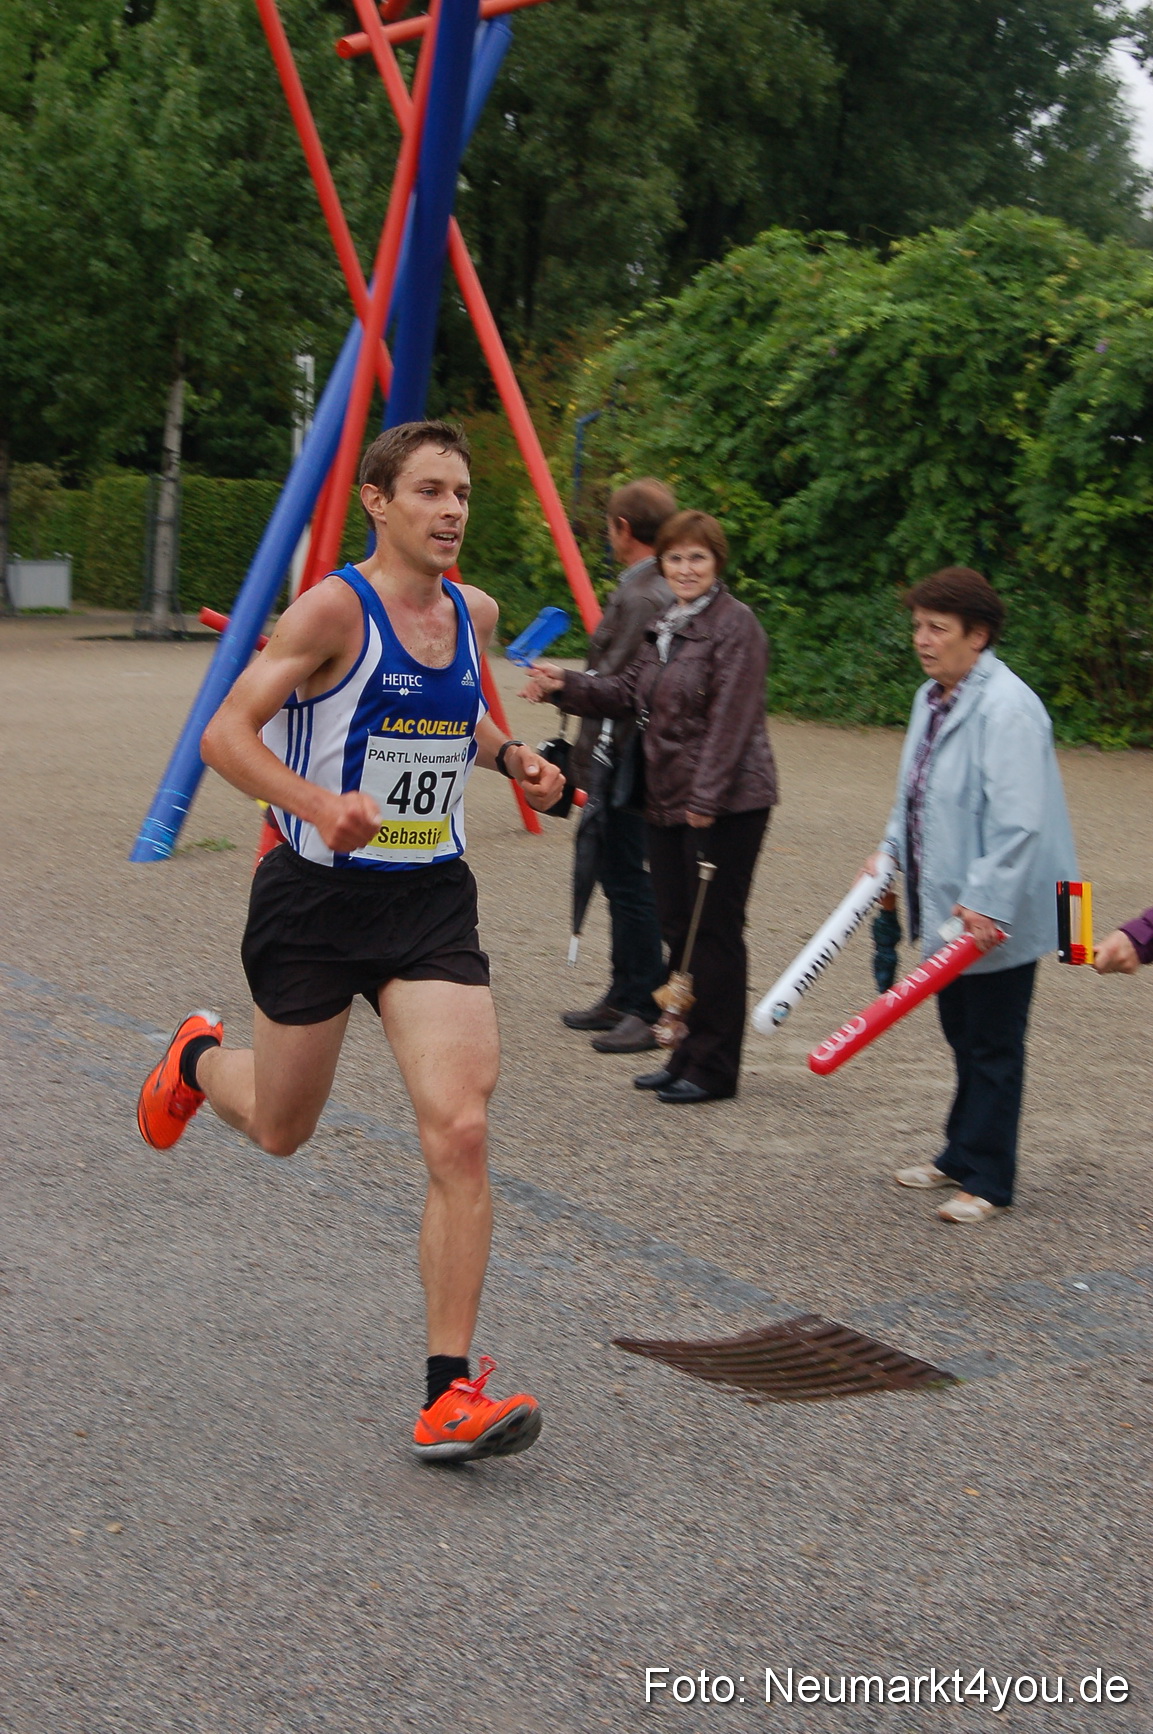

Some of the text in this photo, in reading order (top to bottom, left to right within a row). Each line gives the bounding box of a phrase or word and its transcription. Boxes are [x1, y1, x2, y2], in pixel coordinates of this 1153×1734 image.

[382, 673, 423, 687] HEITEC
[381, 717, 468, 735] LAC QUELLE
[368, 749, 460, 764] PARTL Neumarkt
[386, 770, 457, 815] 487
